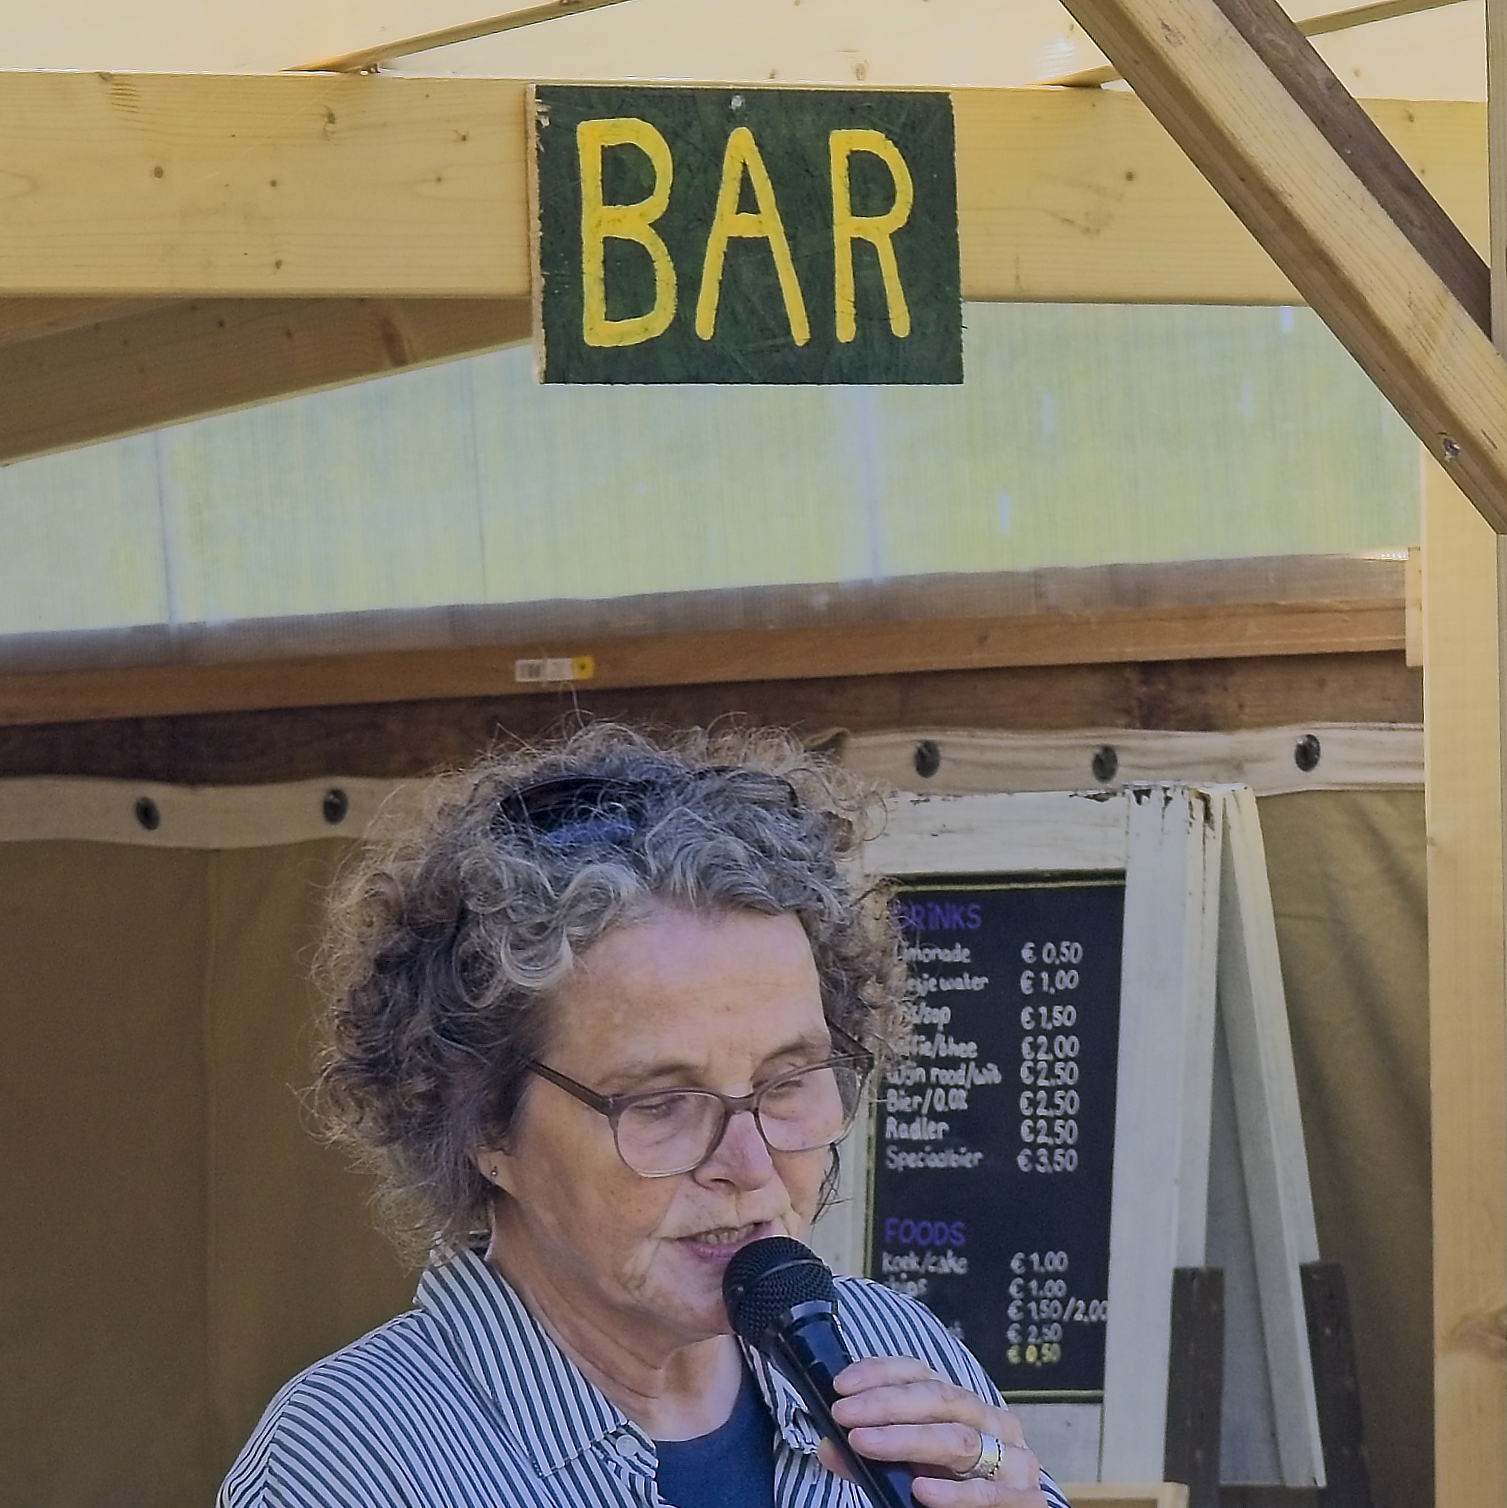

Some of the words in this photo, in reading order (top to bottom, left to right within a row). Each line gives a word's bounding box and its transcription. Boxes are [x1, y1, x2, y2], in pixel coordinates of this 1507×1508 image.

[577, 117, 914, 347] BAR
[939, 972, 990, 991] water
[885, 1115, 950, 1141] Radler
[885, 1217, 966, 1246] FOODS
[884, 1273, 929, 1298] hips
